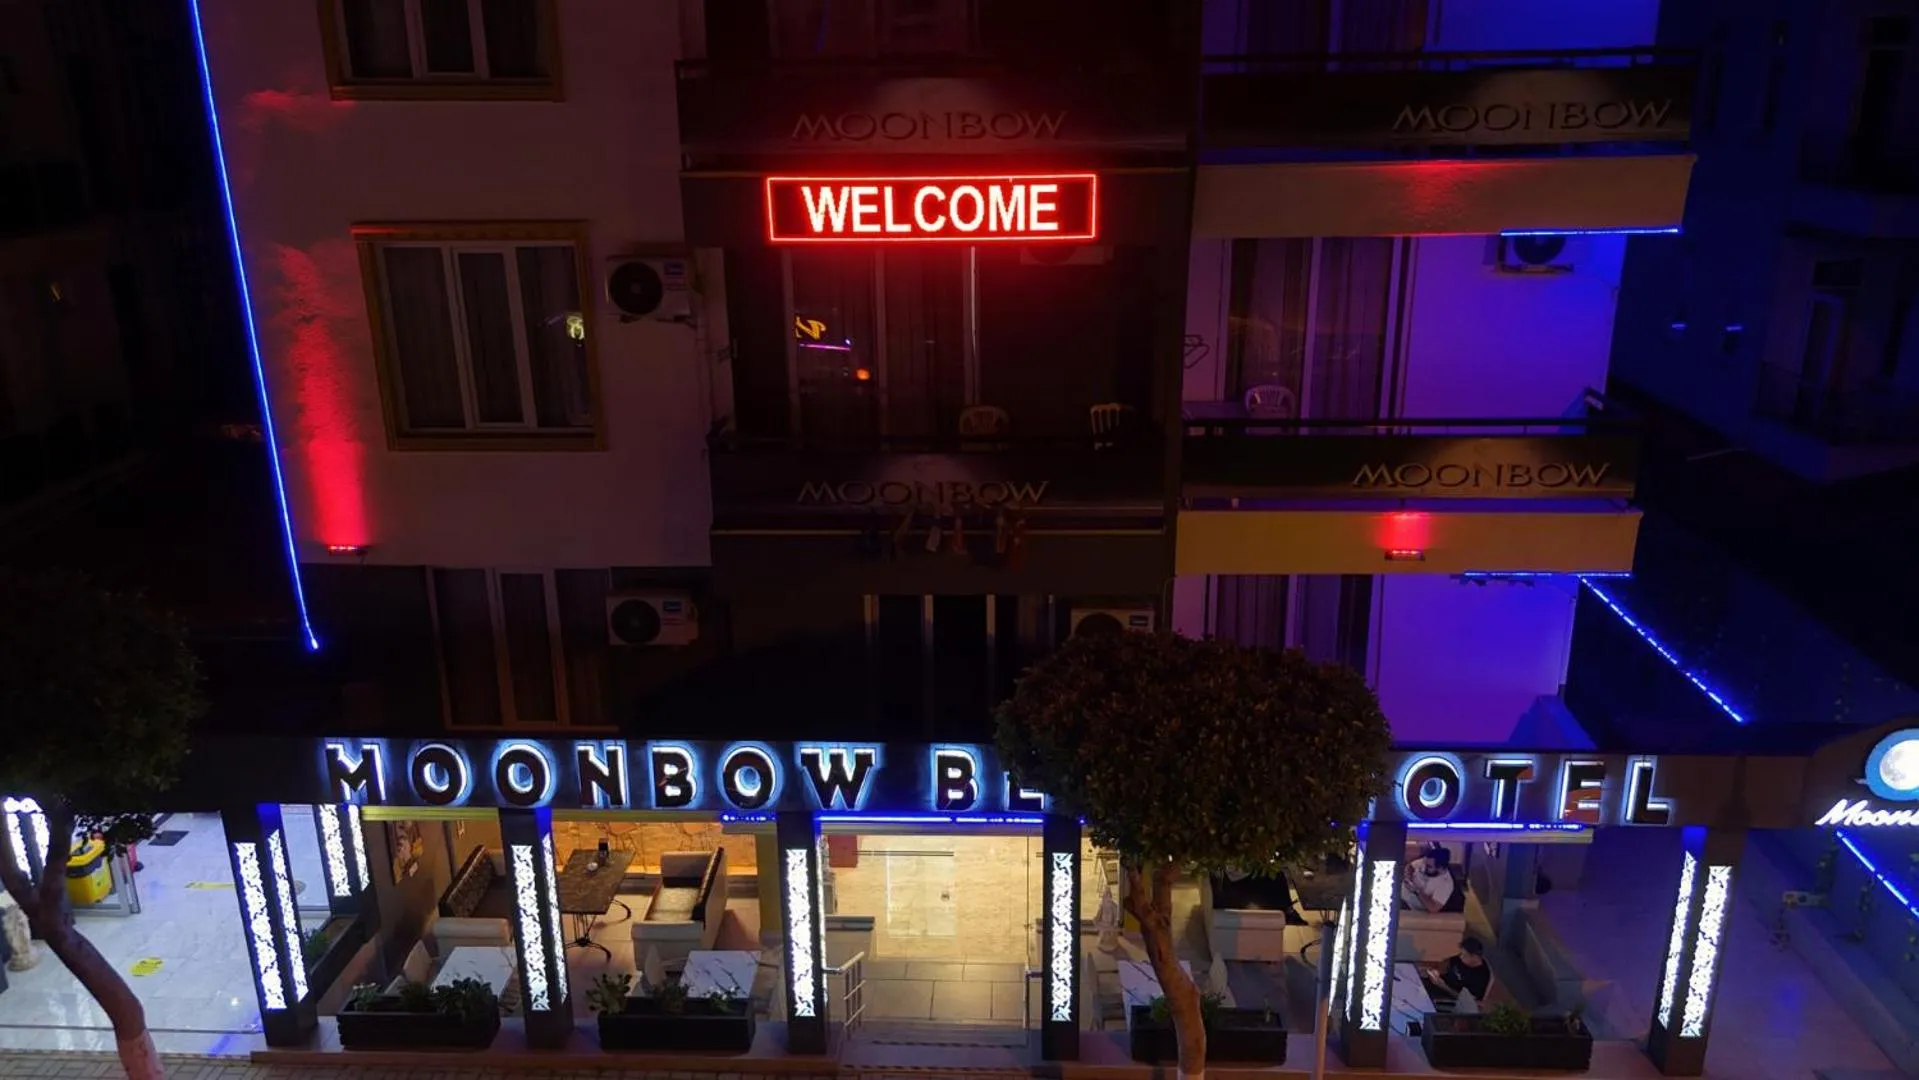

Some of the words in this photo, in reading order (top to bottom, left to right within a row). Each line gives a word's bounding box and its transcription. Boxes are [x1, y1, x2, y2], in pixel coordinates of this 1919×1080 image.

[792, 109, 1067, 141] MOONBOW
[1392, 98, 1672, 133] MOONBOW
[802, 184, 1058, 233] WELCOME
[1353, 461, 1611, 489] MOONBOW
[798, 479, 1049, 506] MOONBOW
[323, 740, 877, 810] MOONBOW
[932, 747, 1048, 812] BL
[1367, 755, 1671, 826] OTEL
[1814, 798, 1919, 827] Moon
